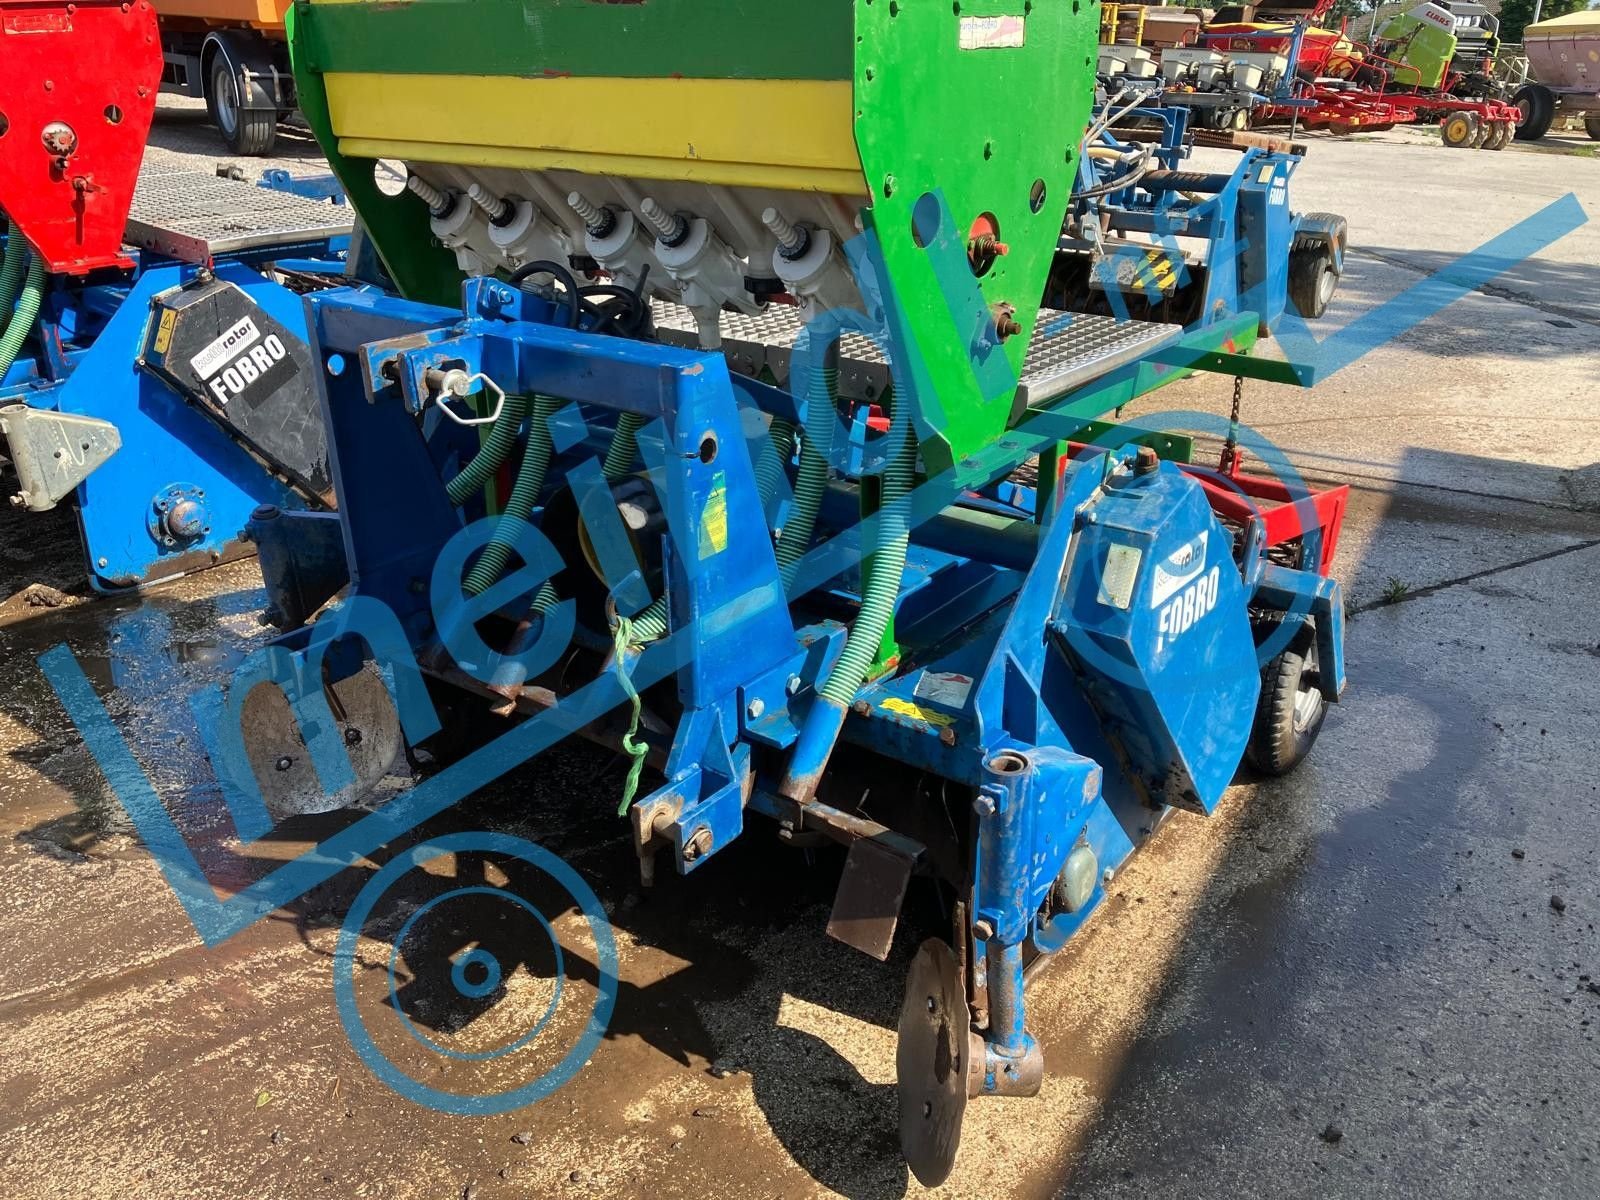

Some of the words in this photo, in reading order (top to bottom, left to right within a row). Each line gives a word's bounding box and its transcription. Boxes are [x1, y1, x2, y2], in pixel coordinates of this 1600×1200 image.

[1425, 10, 1451, 26] CLAAS
[208, 333, 287, 405] FOBRO
[1157, 565, 1220, 653] FOBRO
